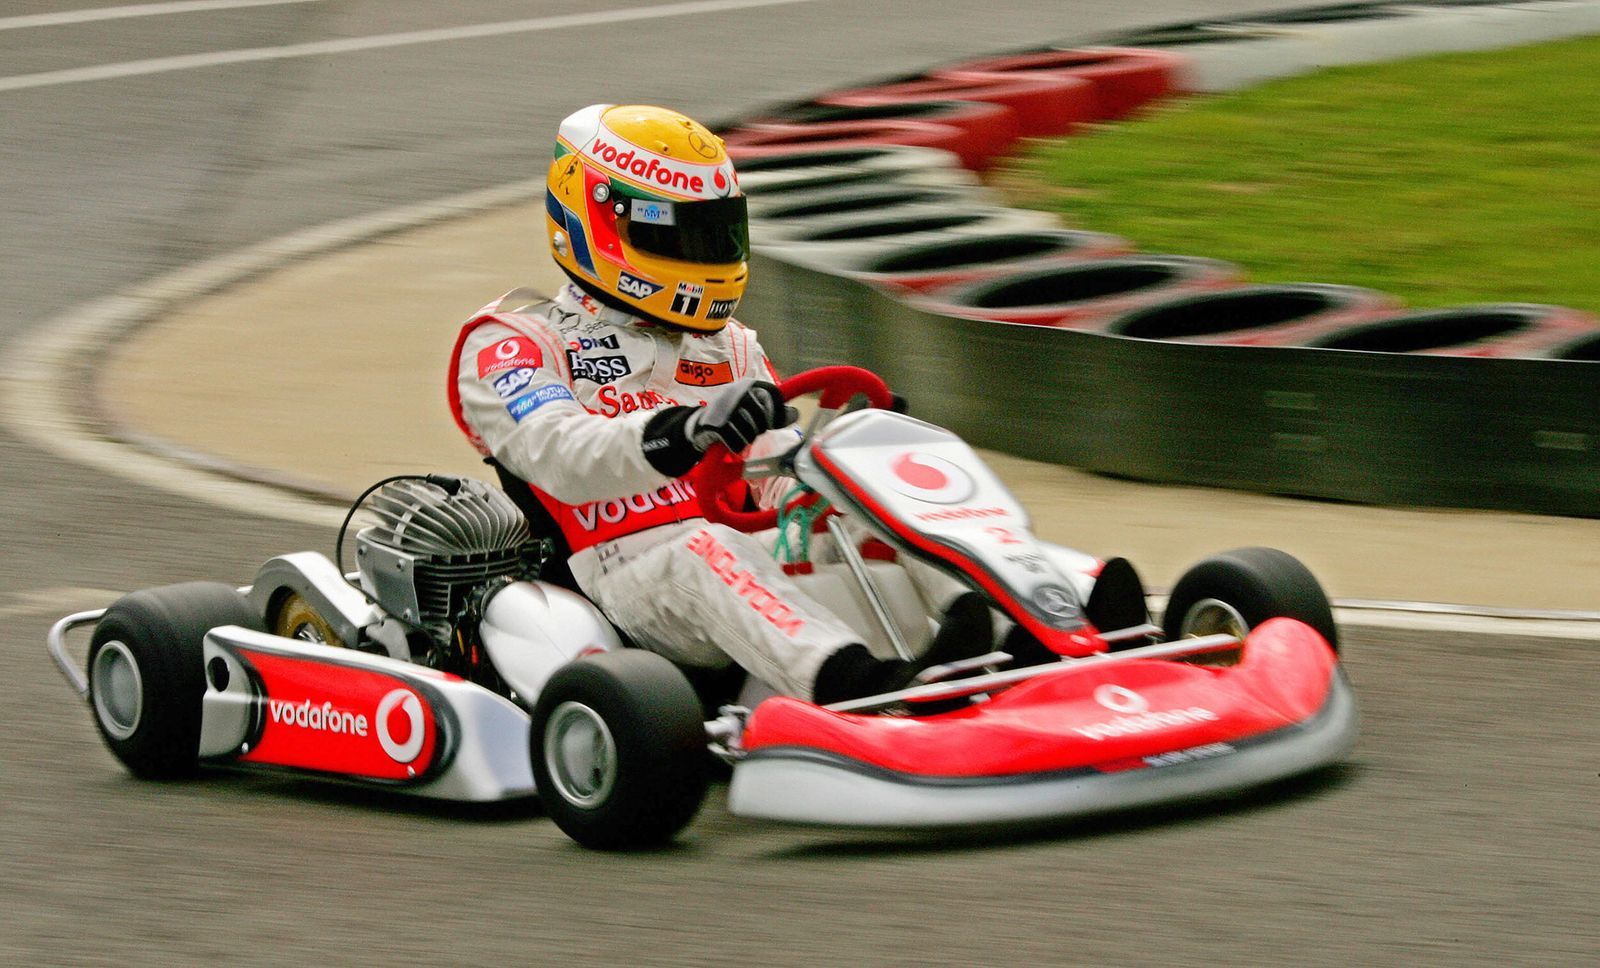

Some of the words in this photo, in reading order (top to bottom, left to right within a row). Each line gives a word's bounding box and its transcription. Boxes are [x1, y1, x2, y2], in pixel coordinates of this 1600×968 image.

[592, 138, 704, 193] vodafone
[618, 275, 653, 298] SAP
[679, 283, 704, 294] Mobil
[681, 297, 691, 315] 1
[484, 358, 535, 373] vodafone
[680, 362, 714, 384] aigo
[495, 368, 534, 398] SAP
[685, 529, 806, 637] VODAFONE
[270, 698, 368, 737] vodafone
